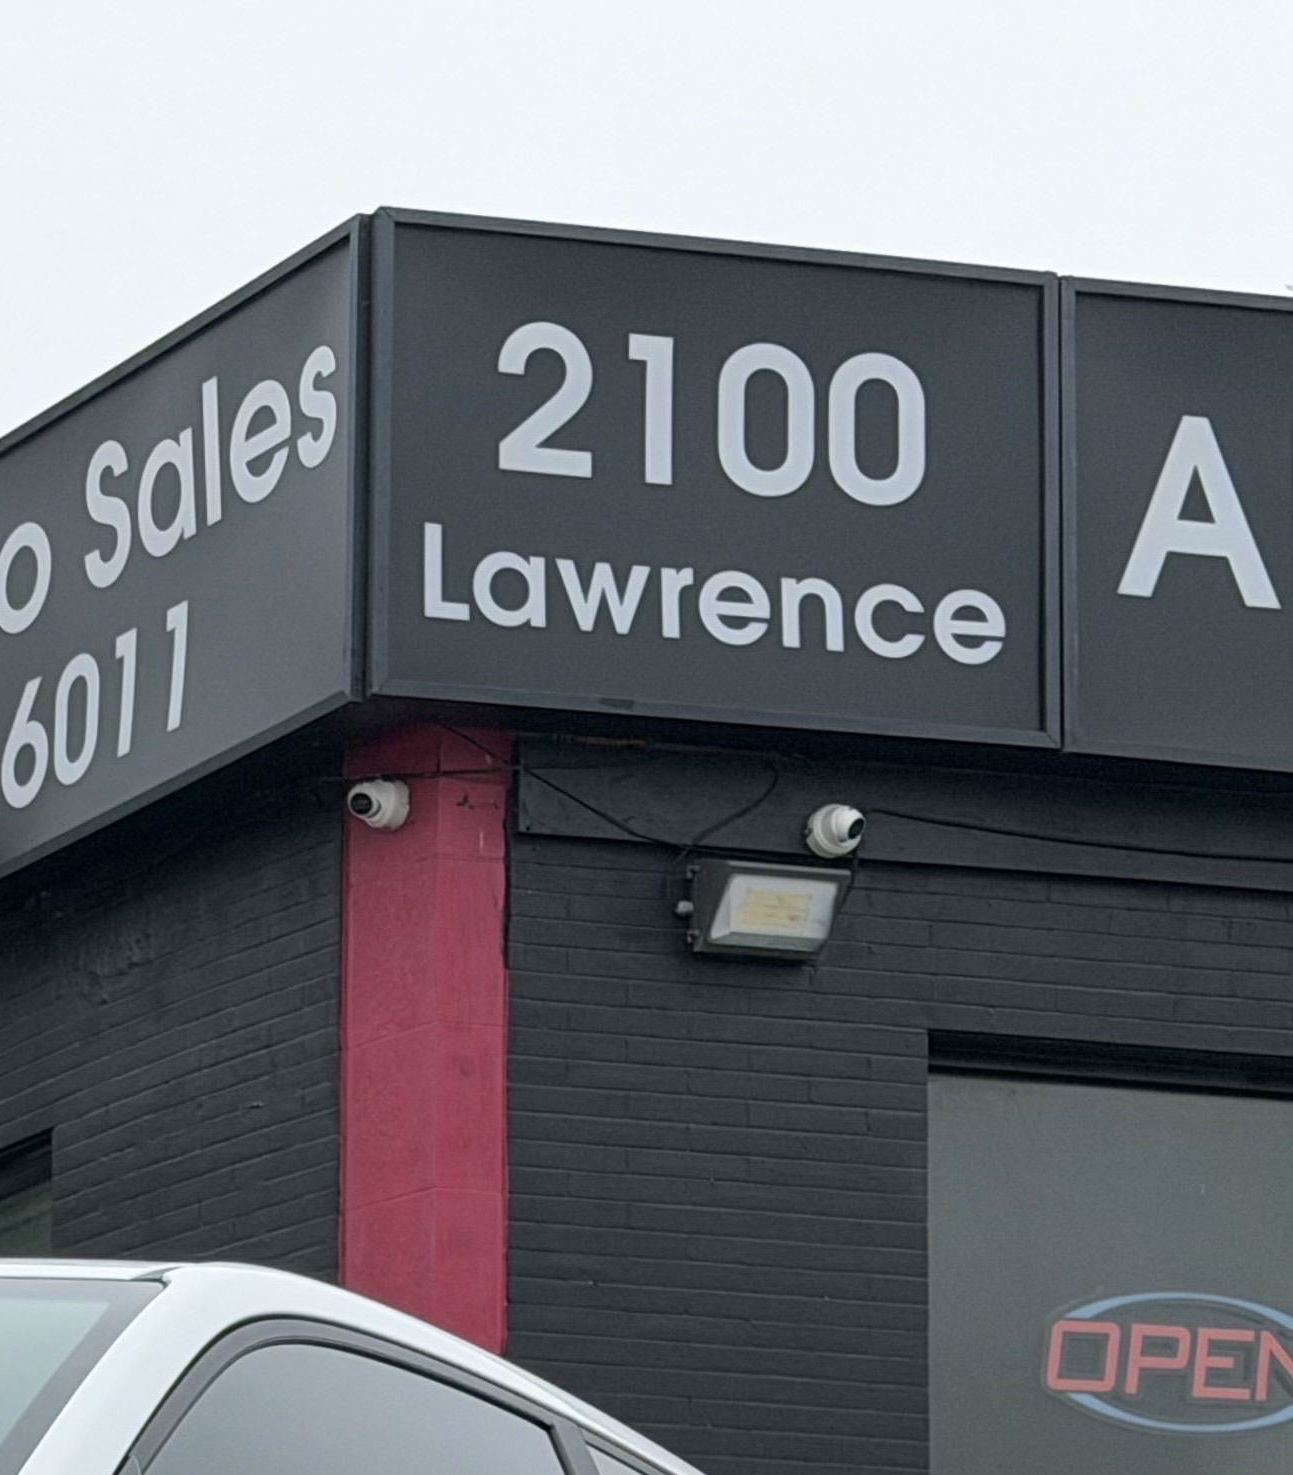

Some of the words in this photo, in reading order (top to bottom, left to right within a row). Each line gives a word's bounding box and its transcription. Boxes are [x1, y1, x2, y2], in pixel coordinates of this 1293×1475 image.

[83, 344, 339, 590] Sales
[497, 320, 927, 507] 2100
[422, 521, 1008, 667] Lawrence
